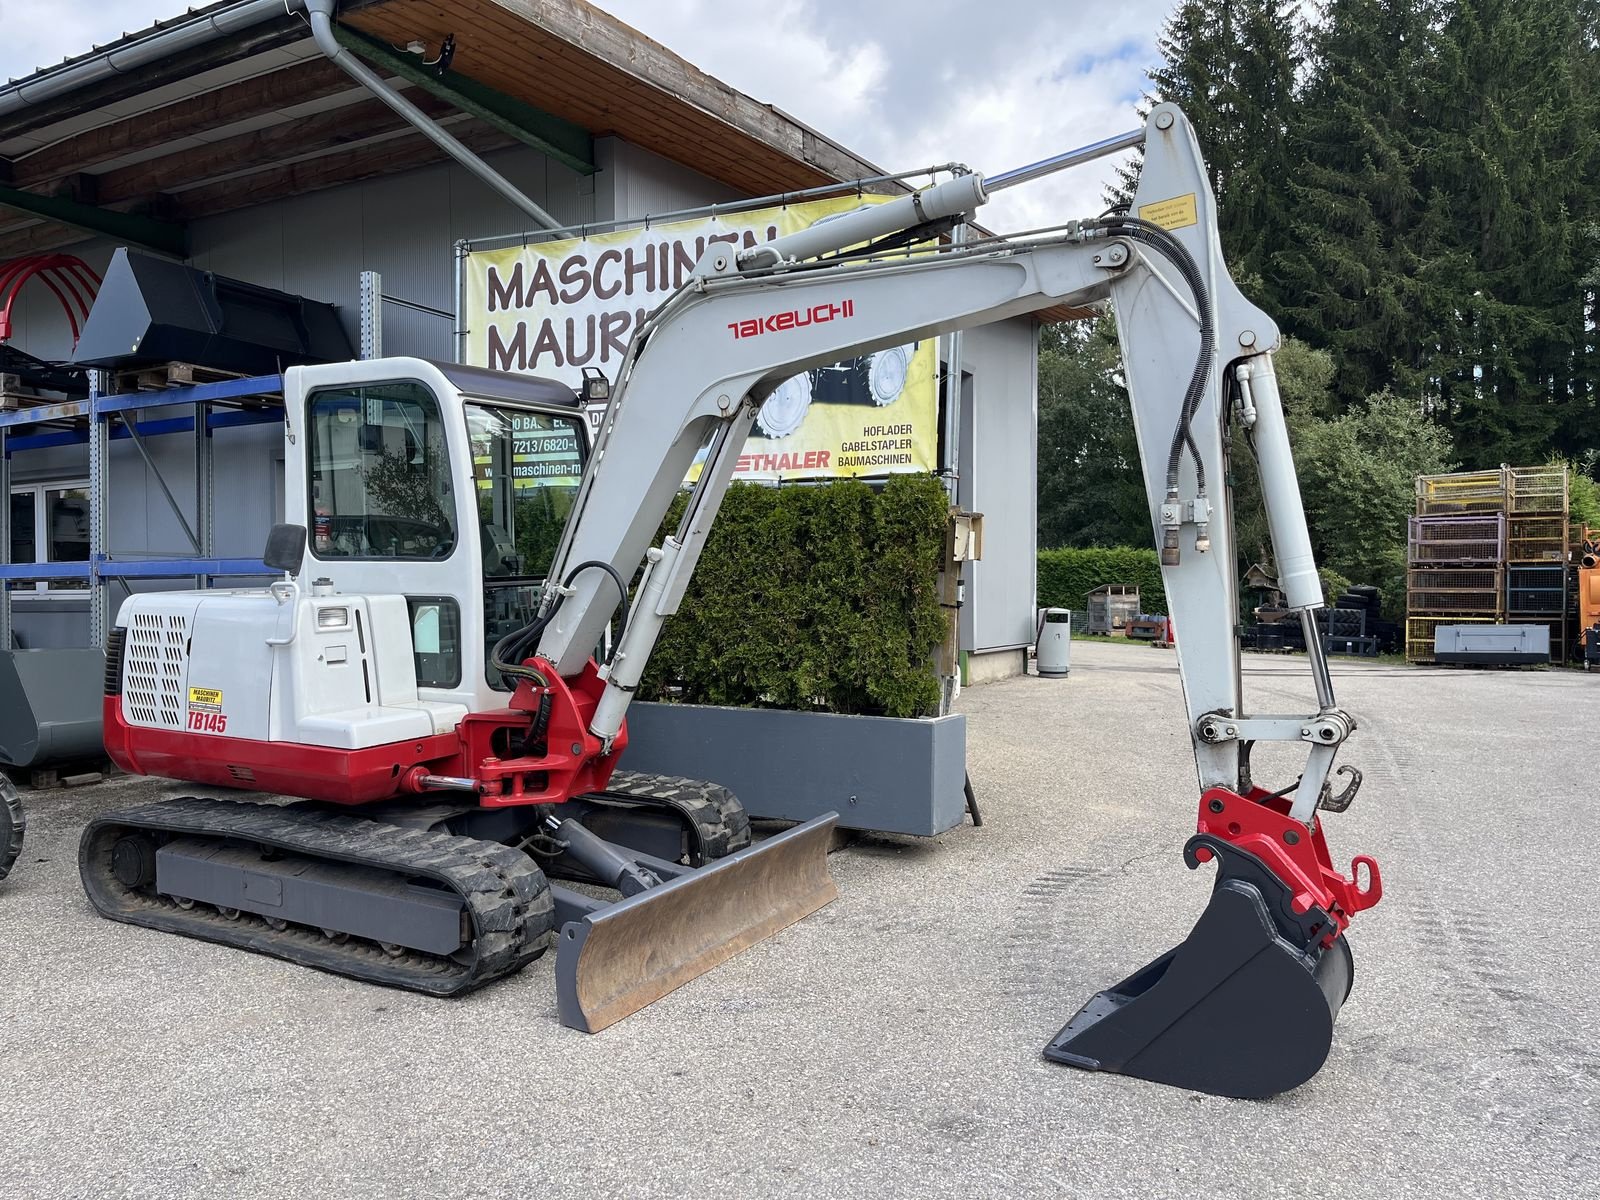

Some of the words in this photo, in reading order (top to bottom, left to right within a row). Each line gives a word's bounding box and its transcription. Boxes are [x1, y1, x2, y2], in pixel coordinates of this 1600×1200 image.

[727, 299, 854, 339] TAKEUCHI
[863, 424, 912, 437] HOFLADER
[512, 439, 578, 453] 7213/6820-
[841, 438, 912, 452] GABELSTAPLER
[838, 453, 912, 467] BAUMASCHINEN
[188, 711, 227, 733] TB145
